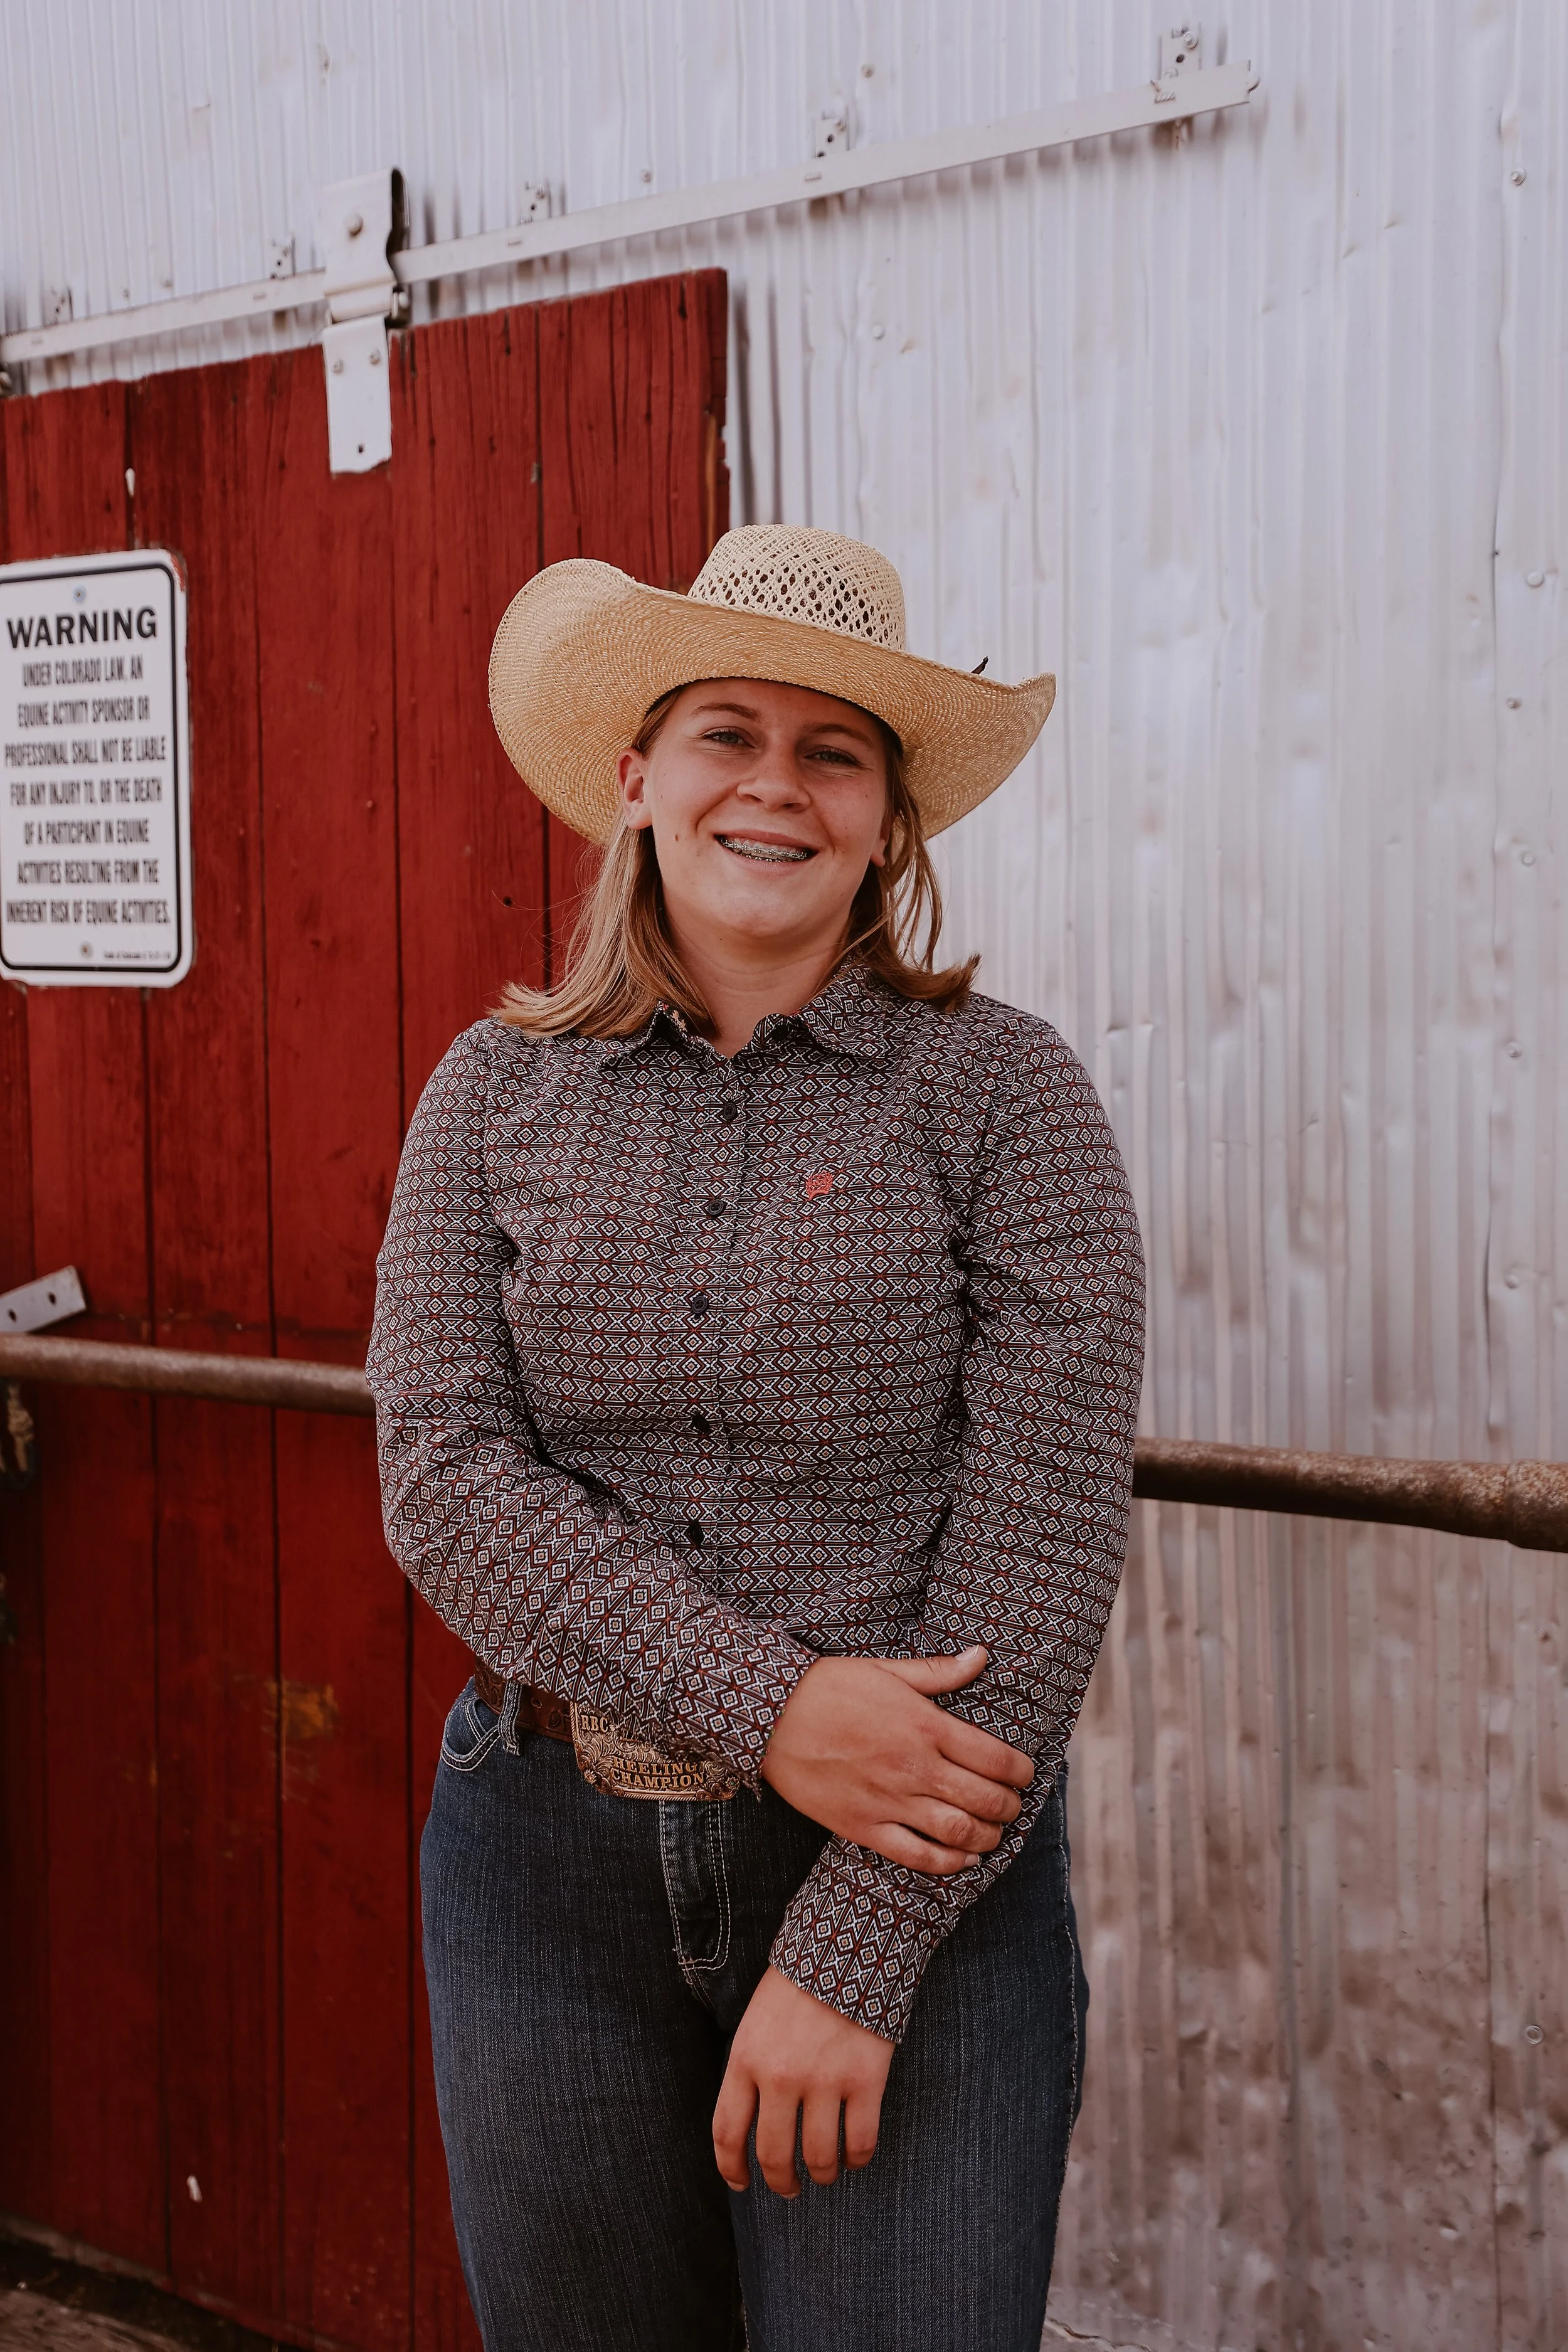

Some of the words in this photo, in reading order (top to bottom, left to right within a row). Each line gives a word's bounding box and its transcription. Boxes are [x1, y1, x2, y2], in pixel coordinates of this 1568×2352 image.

[8, 606, 157, 649] WARNING
[23, 662, 52, 687] UNDER
[55, 658, 102, 684] COLORADO
[130, 654, 143, 680] AN
[18, 702, 49, 727] EQUINE
[53, 699, 88, 724] ACTIVITY
[92, 697, 135, 723] SPONSOR
[137, 695, 150, 720] OR
[5, 741, 68, 766] PROFESSIONAL
[72, 738, 98, 763] SHALL
[102, 737, 119, 762] NOT
[122, 736, 132, 761] BE
[136, 735, 166, 761] LIABLE
[11, 781, 26, 805] FOR
[30, 781, 46, 804] ANY
[50, 780, 80, 804] INJURY
[100, 778, 112, 803] OR
[115, 778, 130, 802] THE
[134, 776, 162, 802] DEATH
[24, 820, 34, 844] OF
[38, 821, 43, 844] A
[46, 820, 101, 844] PARTICIPANT
[105, 820, 114, 842] IN
[117, 818, 150, 844] EQUINE
[18, 861, 61, 884] ACTIVITIES
[65, 861, 112, 883] RESULTING
[115, 859, 139, 883] FROM
[143, 859, 159, 883] THE
[6, 900, 47, 923] INHERENT
[51, 900, 70, 923] RISK
[73, 900, 83, 923] OF
[87, 899, 117, 925] EQUINE
[581, 1714, 608, 1733] RBC
[610, 1767, 705, 1788] CHAMPION
[613, 1756, 697, 1776] HEELING
